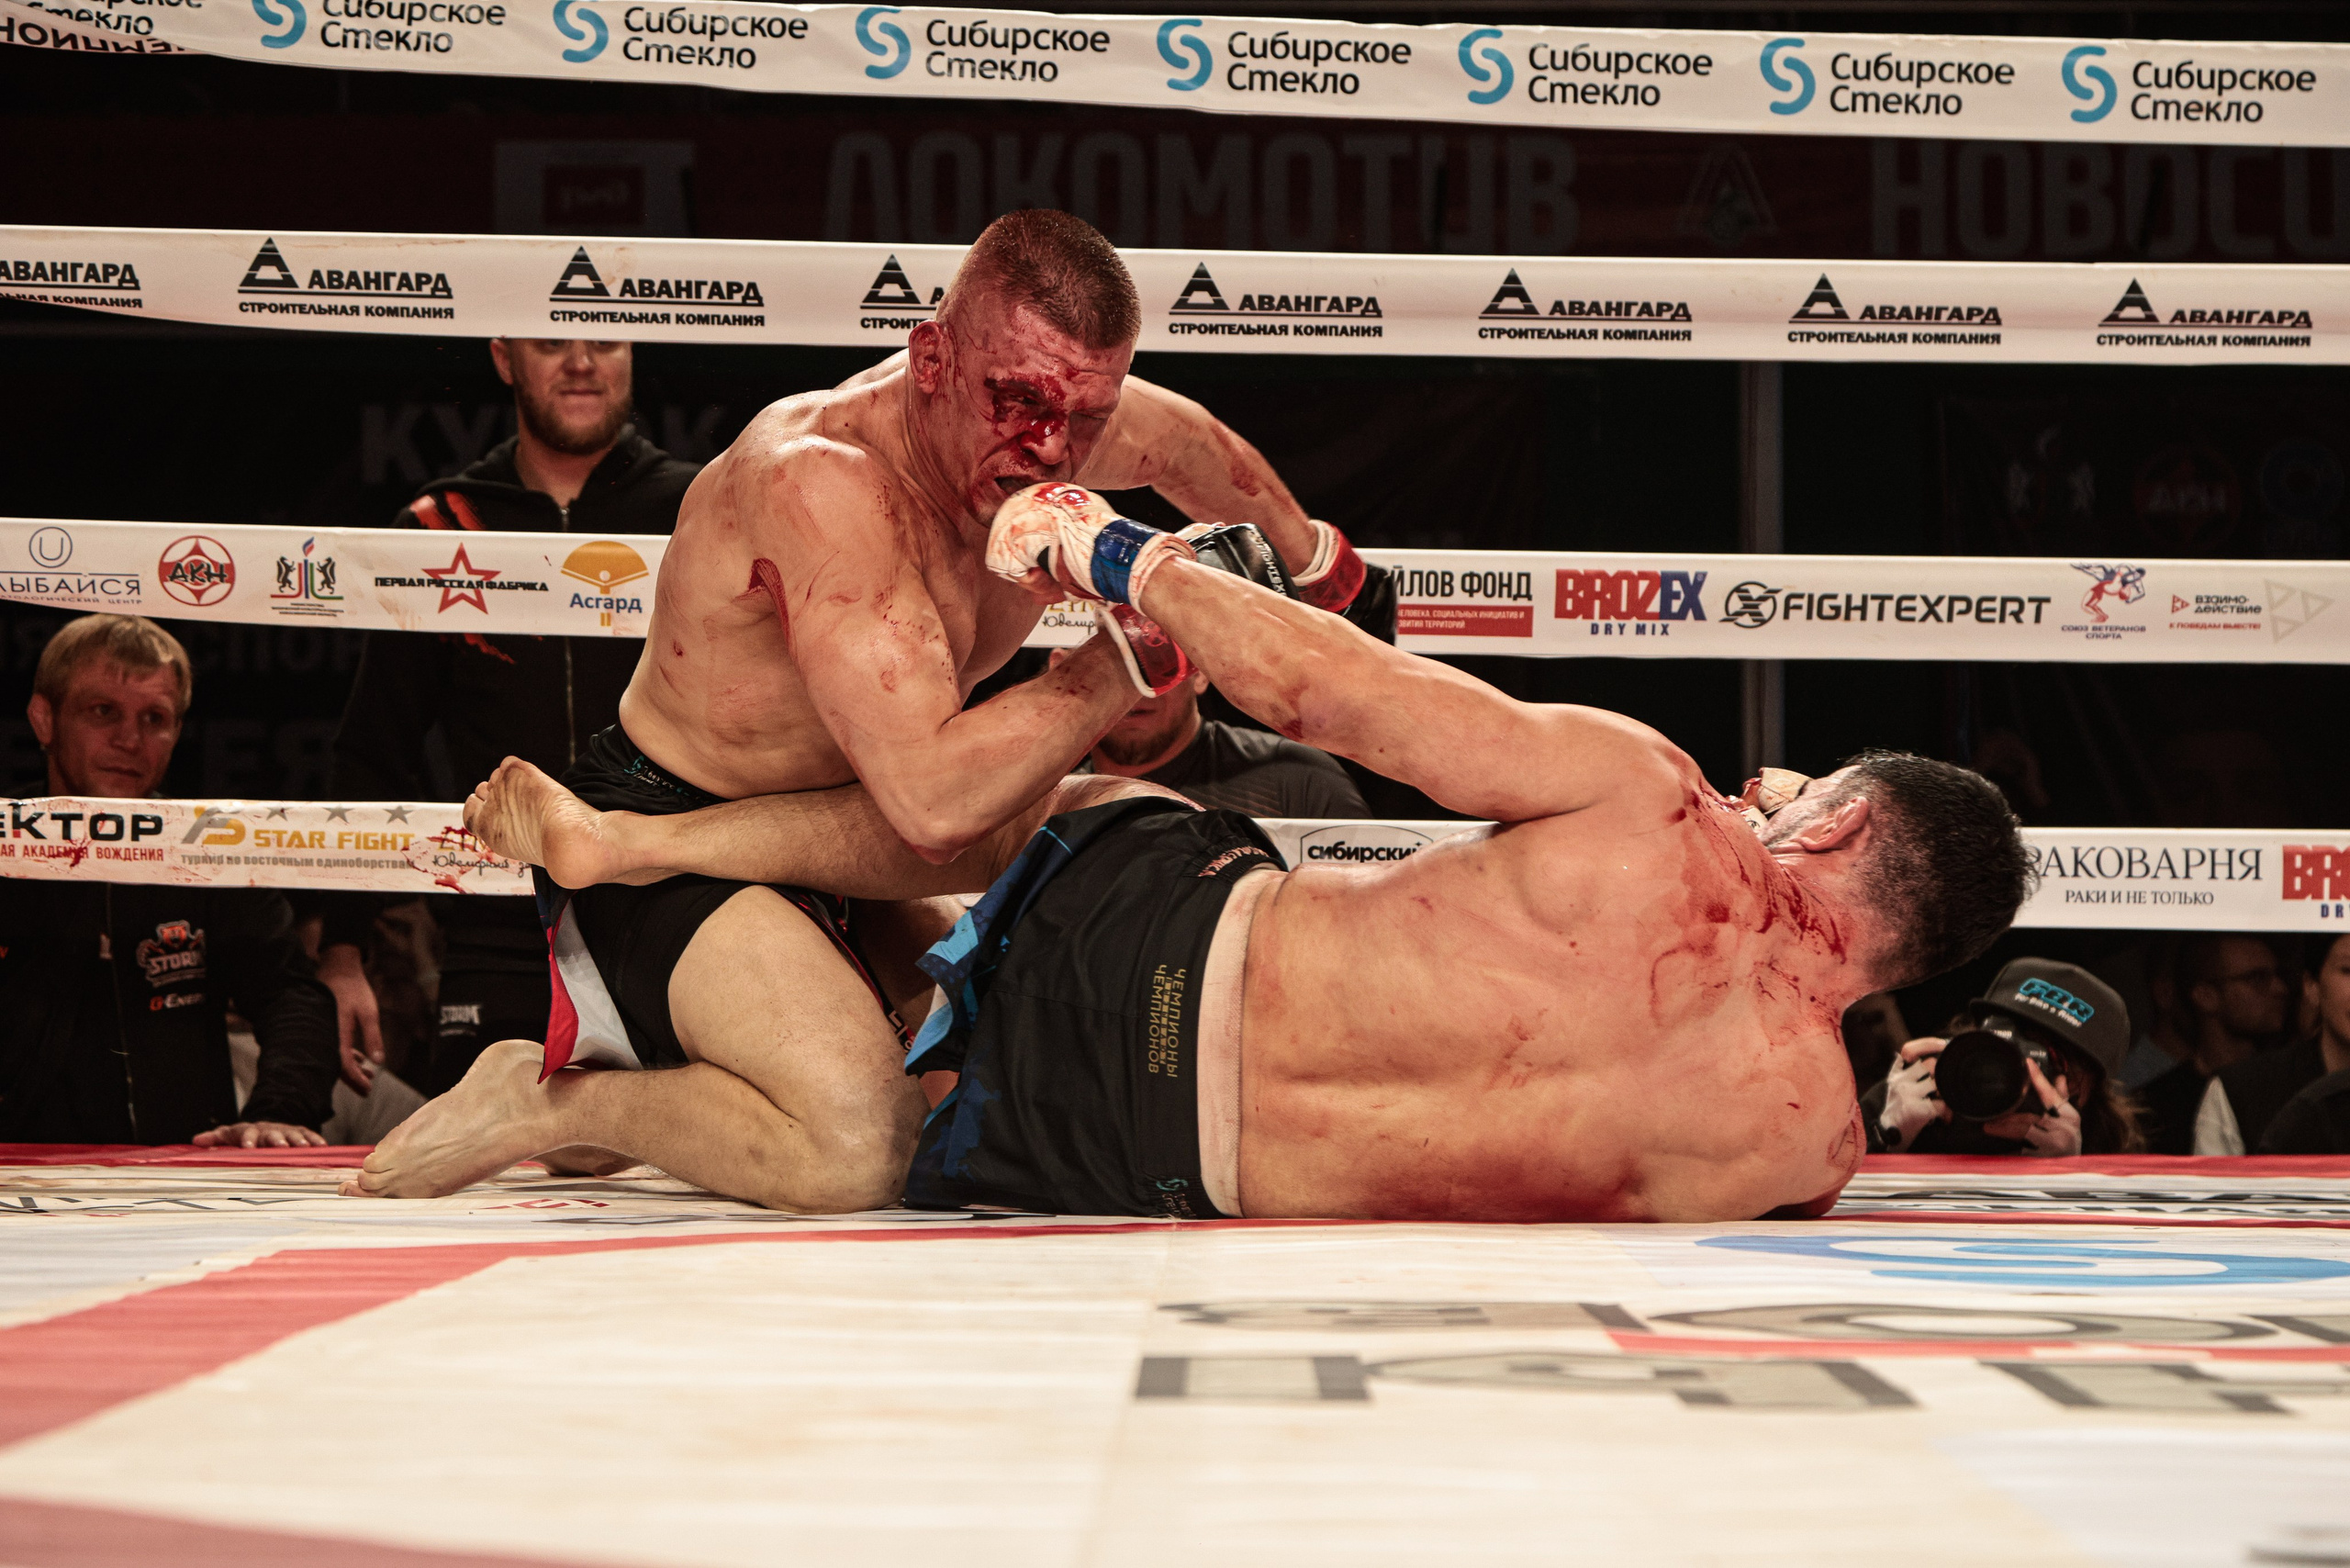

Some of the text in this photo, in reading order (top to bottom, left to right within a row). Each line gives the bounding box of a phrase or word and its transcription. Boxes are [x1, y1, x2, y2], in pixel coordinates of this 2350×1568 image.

[322, 0, 506, 26] Сибирское
[624, 7, 808, 38] Сибирское
[320, 20, 453, 52] Стекло
[926, 19, 1110, 50] Сибирское
[1227, 31, 1411, 62] Сибирское
[623, 38, 756, 69] Стекло
[925, 50, 1058, 82] Стекло
[1528, 44, 1712, 75] Сибирское
[1226, 63, 1360, 95] Стекло
[1831, 53, 2015, 84] Сибирское
[2132, 61, 2316, 92] Сибирское
[1528, 74, 1661, 106] Стекло
[1830, 84, 1963, 115] Стекло
[2131, 92, 2264, 123] Стекло
[0, 261, 140, 289] АВАНГАРД
[308, 269, 453, 297] АВАНГАРД
[52, 295, 143, 308] КОМПАНИЯ
[620, 278, 764, 307] АВАНГАРД
[1238, 295, 1382, 318] АВАНГАРД
[239, 302, 453, 319] СТРОИТЕЛЬНАЯ КОМПАНИЯ
[550, 310, 765, 326] СТРОИТЕЛЬНАЯ КОМПАНИЯ
[1549, 300, 1693, 322] АВАНГАРД
[1859, 305, 2003, 326] АВАНГАРД
[2169, 308, 2313, 330] АВАНГАРД
[1169, 323, 1382, 337] СТРОИТЕЛЬНАЯ КОМПАНИЯ
[1479, 328, 1691, 341] СТРОИТЕЛЬНАЯ КОМПАНИЯ
[1788, 331, 2001, 344] СТРОИТЕЛЬНАЯ КОМПАНИЯ
[2097, 334, 2311, 346] СТРОИТЕЛЬНАЯ КОМПАНИЯ
[375, 577, 548, 591] ПЕРВАЯ РУССКАЯ ФАБРИКА
[1460, 570, 1533, 601] ФОНД
[1554, 569, 1707, 621] BROZEX
[569, 592, 643, 613] Асгард
[1783, 592, 2052, 624] FIGHTEXPERT
[1591, 623, 1670, 635] DRY MIX
[0, 801, 163, 842] КТОР
[22, 845, 89, 860] АКАДЕМЯ
[95, 846, 164, 861] ВОЖДЕНИЯ
[254, 829, 326, 849] STAR
[337, 831, 416, 851] FIGHT
[243, 855, 314, 868] восточным
[2065, 890, 2214, 906] РАКИ И НЕ ТОЛЬКО
[1147, 964, 1168, 1074] ЧЕМПИОНОВ
[1166, 968, 1187, 1078] ЧЕМПИОНЫ
